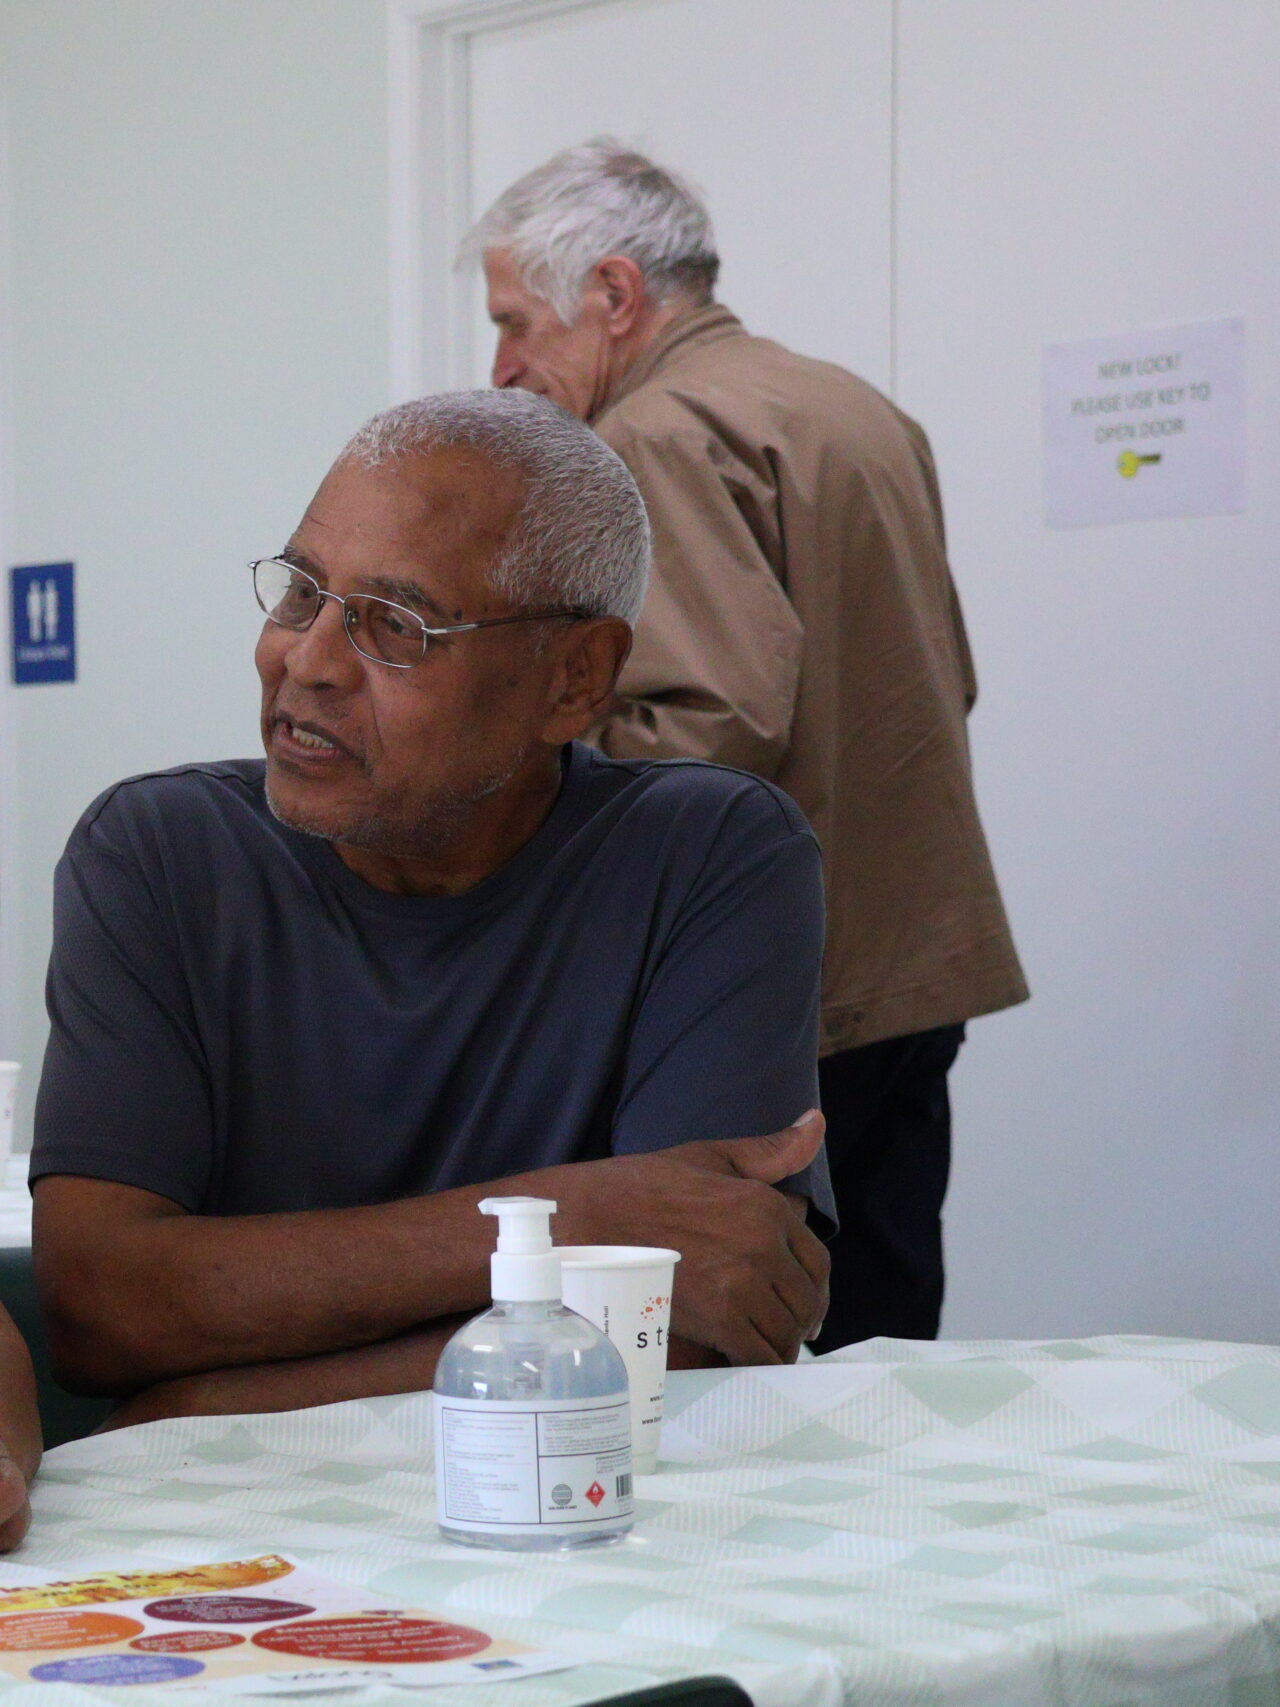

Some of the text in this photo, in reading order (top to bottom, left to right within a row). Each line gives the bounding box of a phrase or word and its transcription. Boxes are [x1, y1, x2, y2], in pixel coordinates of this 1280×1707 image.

[1098, 354, 1180, 379] NEW LOCK!
[1072, 381, 1211, 415] PLEASE USE KEY TO
[1095, 417, 1184, 444] OPEN DOOR
